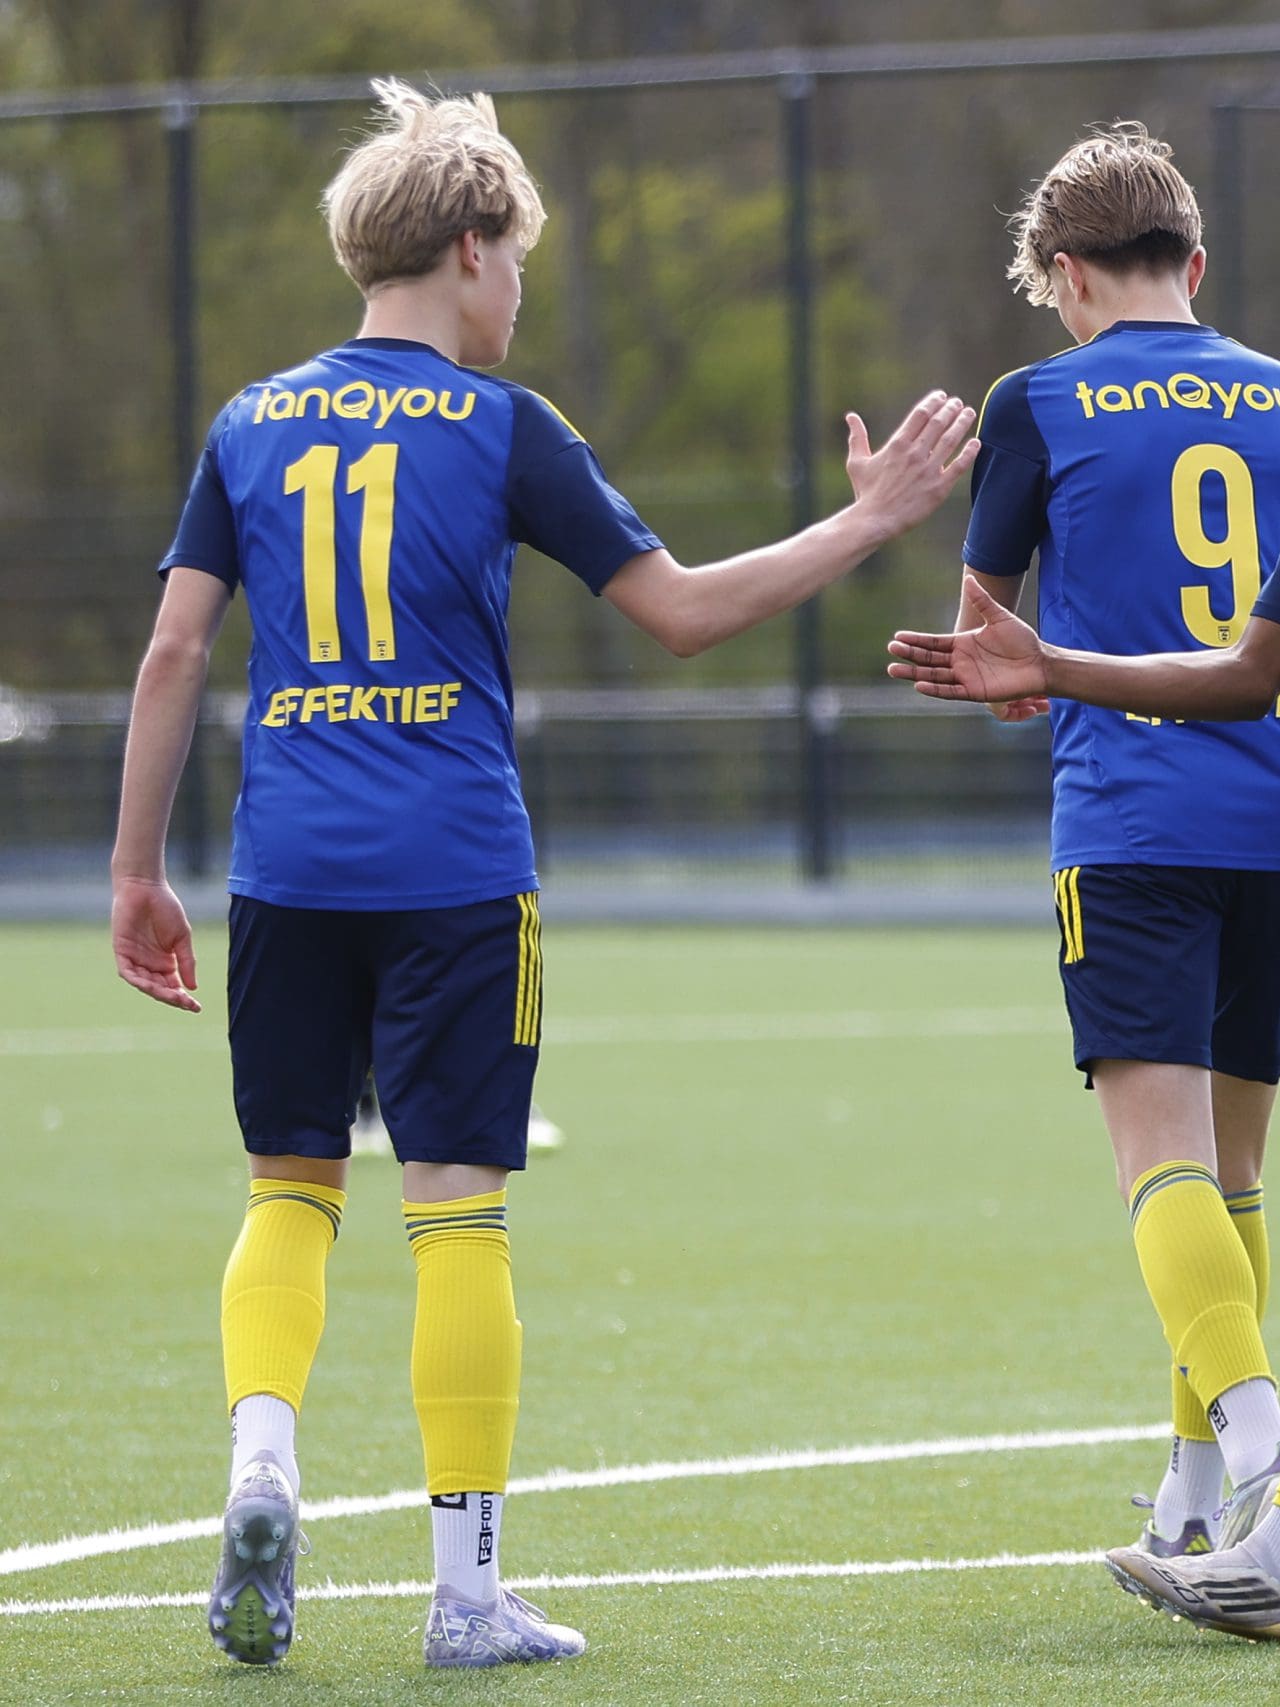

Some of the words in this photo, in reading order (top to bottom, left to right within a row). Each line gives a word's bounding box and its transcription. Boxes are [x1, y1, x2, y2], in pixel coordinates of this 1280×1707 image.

[253, 380, 476, 429] tanQyou
[283, 443, 399, 664] 11
[1171, 443, 1261, 648] 9
[260, 681, 463, 728] EFFEKTIEF
